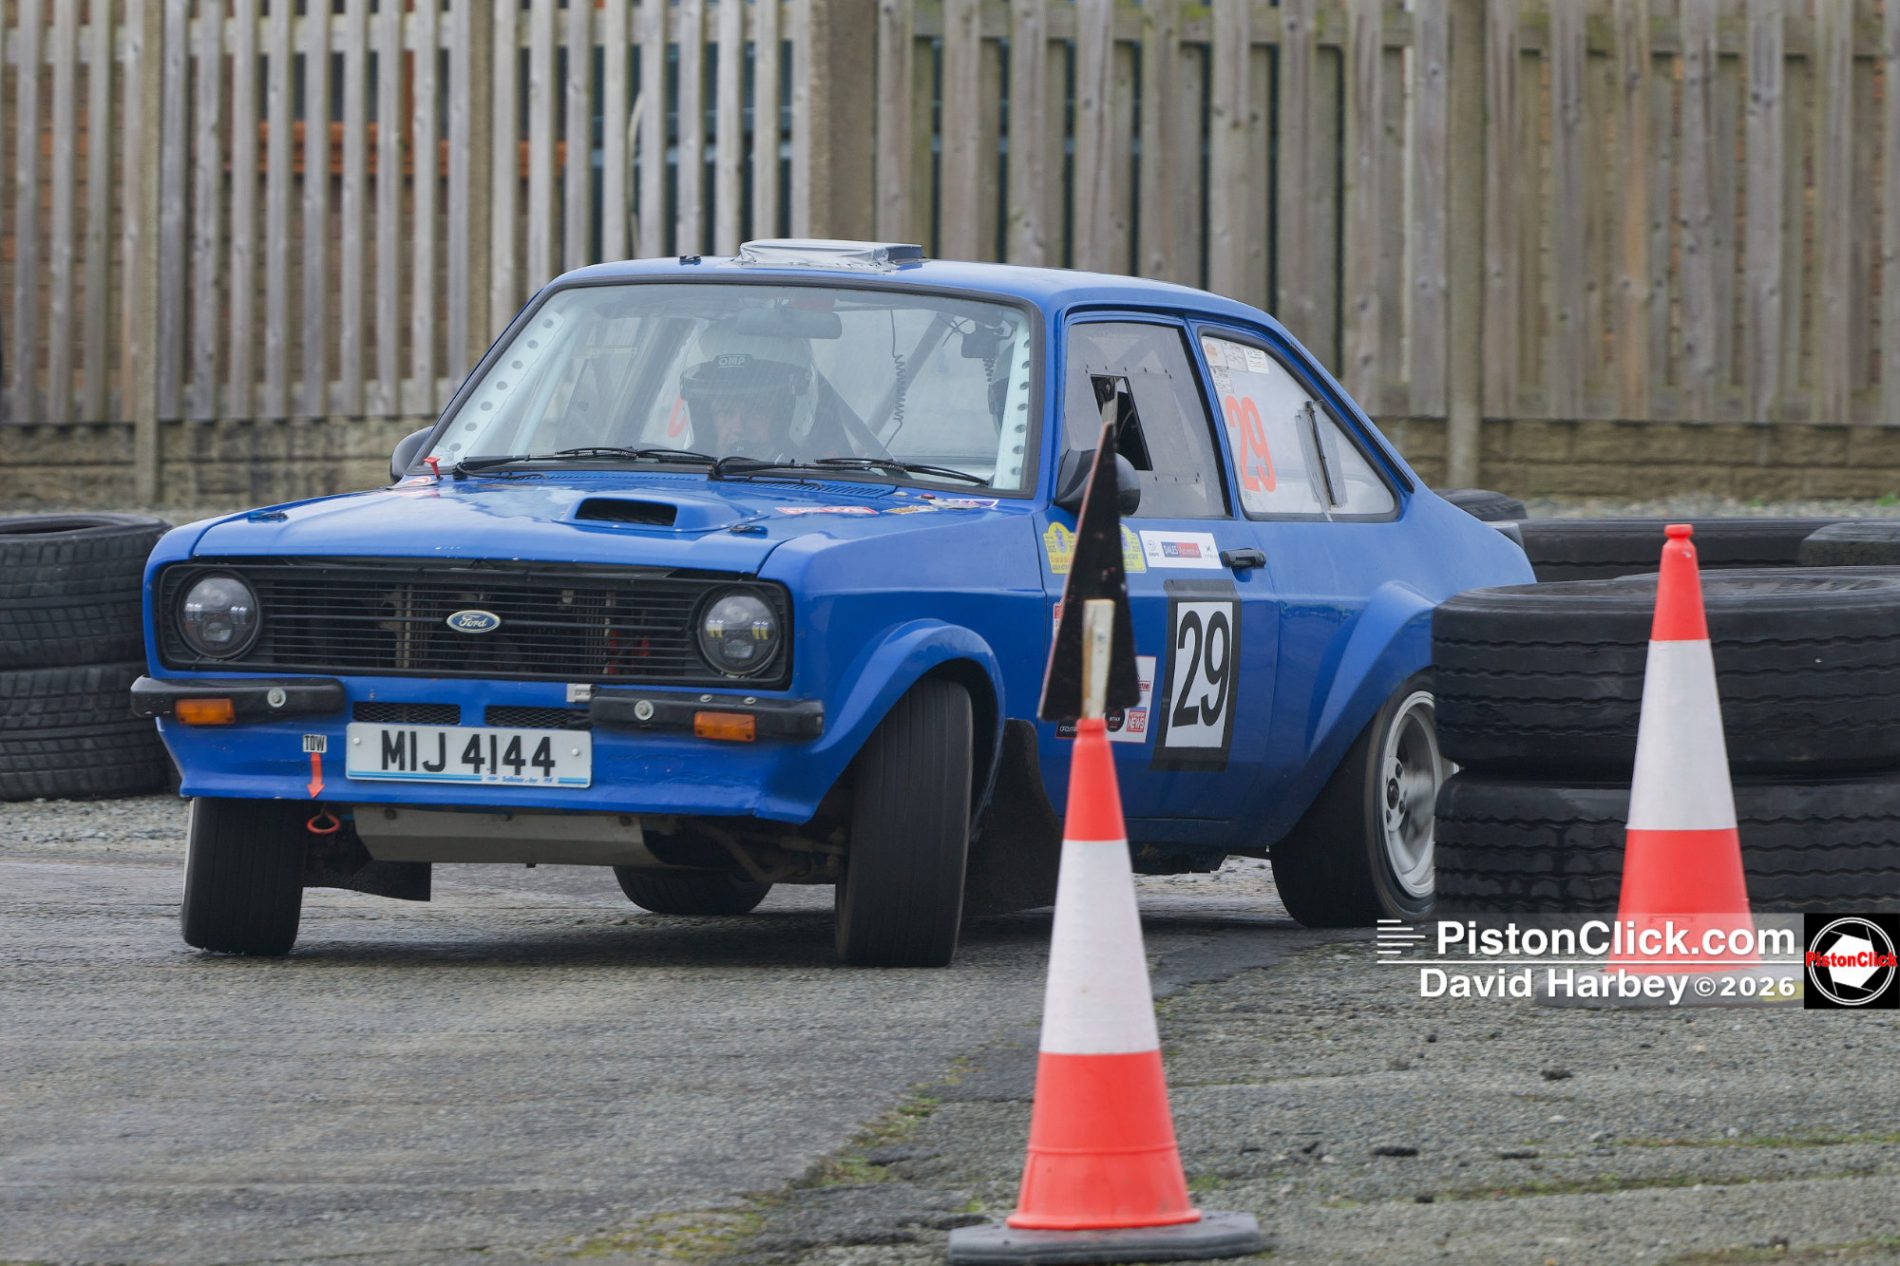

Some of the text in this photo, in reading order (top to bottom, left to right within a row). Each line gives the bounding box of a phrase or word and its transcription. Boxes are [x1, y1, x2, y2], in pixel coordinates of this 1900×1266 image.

[718, 356, 746, 366] OMP
[1225, 395, 1276, 492] 29
[458, 613, 489, 627] Ford
[1172, 609, 1231, 728] 29
[303, 735, 326, 752] TOW
[381, 730, 556, 777] MIJ 4144
